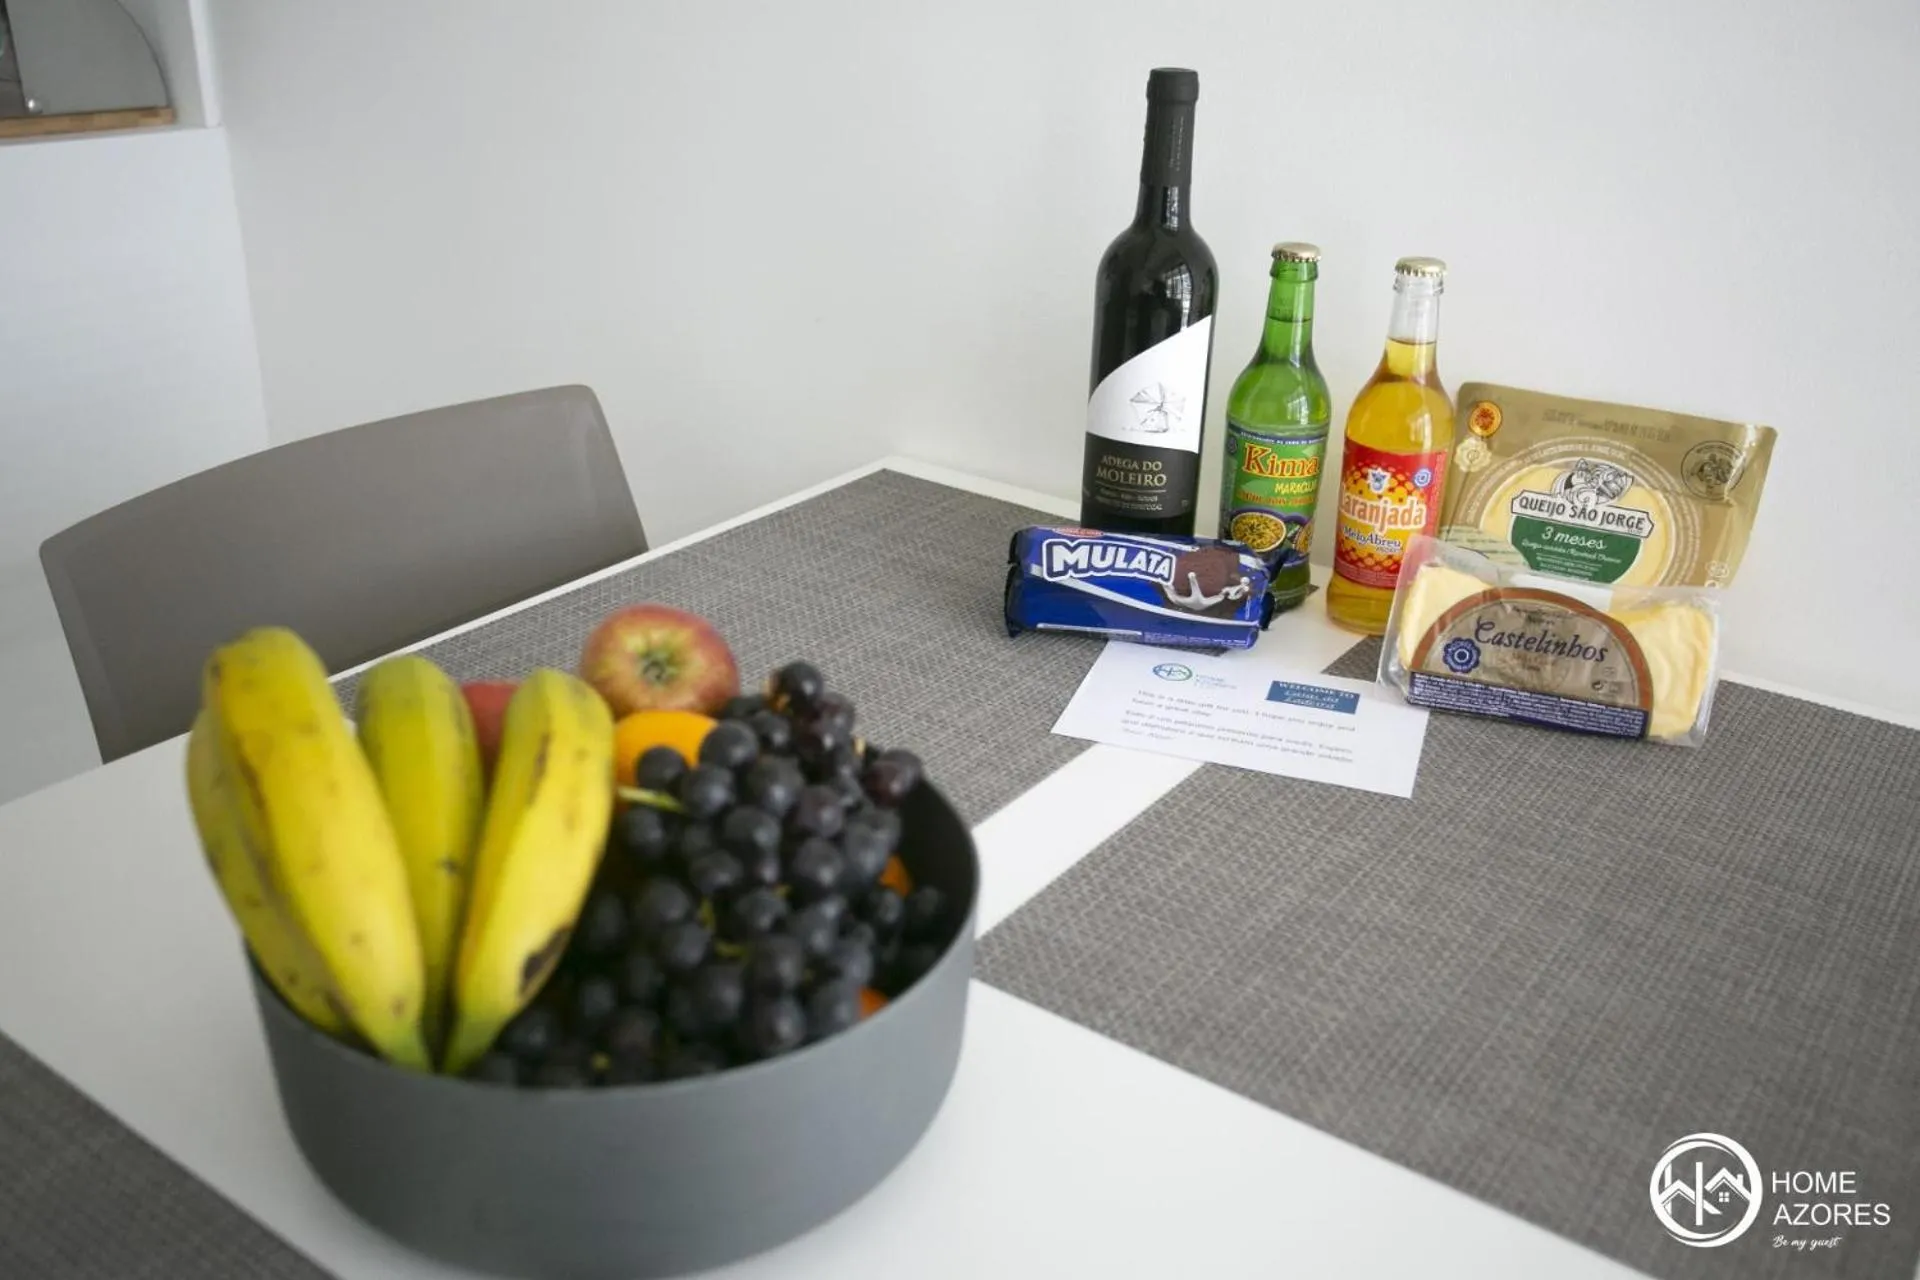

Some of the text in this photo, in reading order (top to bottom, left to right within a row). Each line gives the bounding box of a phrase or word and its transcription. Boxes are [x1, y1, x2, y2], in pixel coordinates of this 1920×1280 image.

[1096, 466, 1167, 487] MOLEIRO
[1102, 455, 1162, 471] ADEGA DO
[1243, 443, 1319, 477] Kima
[1341, 496, 1425, 534] aranjada
[1519, 496, 1565, 516] QUEIJO
[1569, 504, 1597, 522] SÃO
[1600, 511, 1645, 531] JORGE
[1541, 526, 1607, 550] 3 meses
[1047, 540, 1175, 583] MULATA
[1473, 616, 1609, 664] Castelinhos
